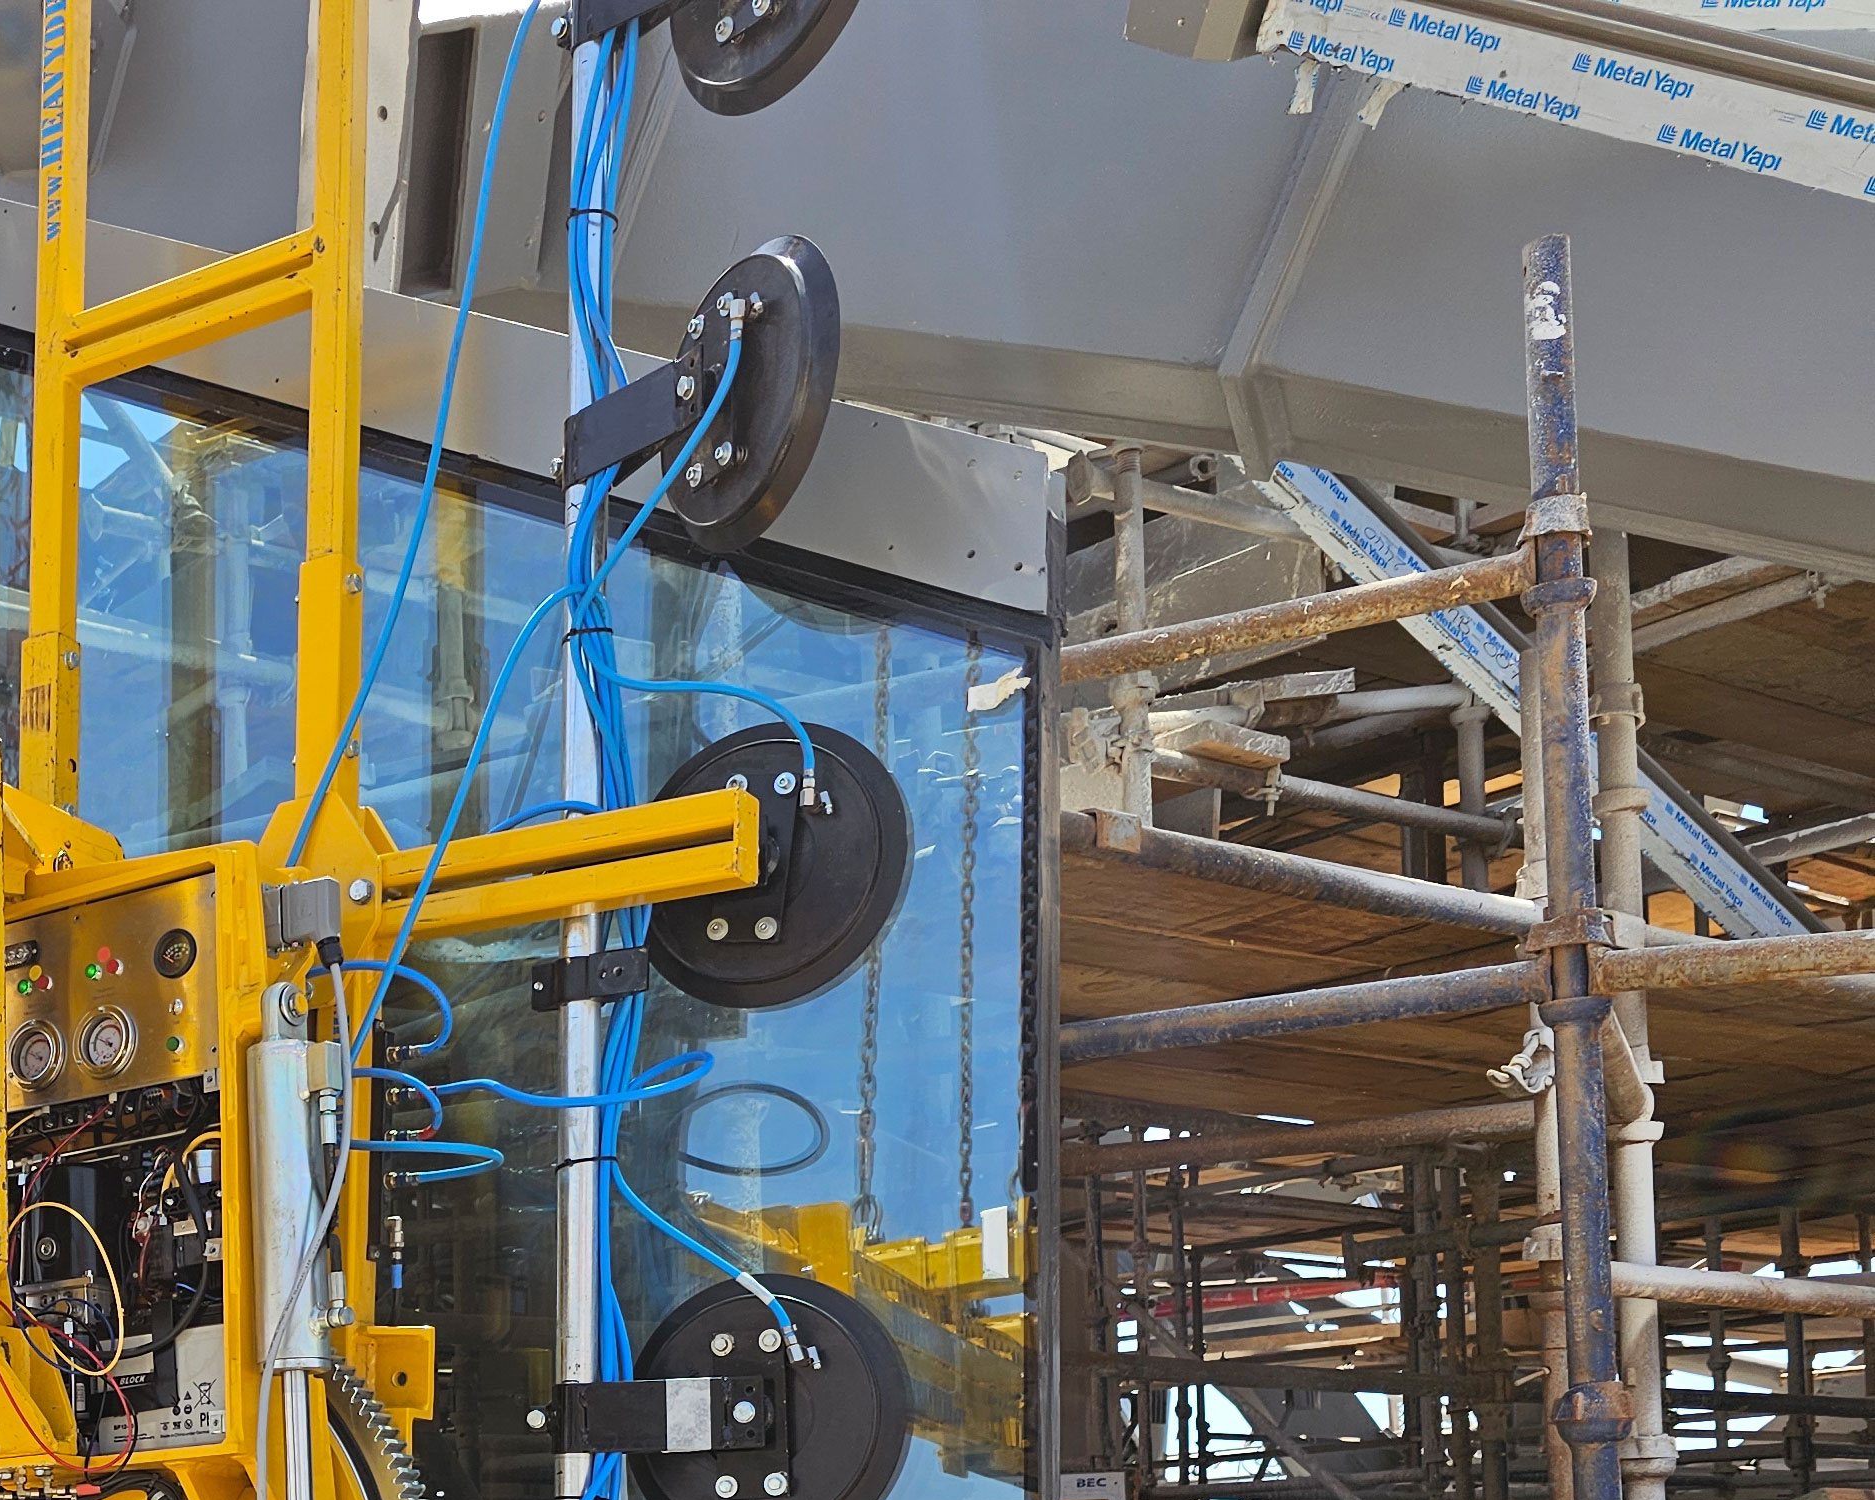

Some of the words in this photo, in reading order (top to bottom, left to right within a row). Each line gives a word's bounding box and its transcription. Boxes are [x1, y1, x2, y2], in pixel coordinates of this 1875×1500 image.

[1408, 14, 1460, 41] Metal
[1465, 26, 1501, 51] Yapı
[1308, 34, 1356, 61] Metal
[1358, 49, 1395, 73] Yapı
[1594, 57, 1651, 87] Metal
[1654, 71, 1695, 100] Yapı
[1486, 80, 1541, 109] Metal
[1543, 95, 1581, 120] Yapı
[1829, 114, 1875, 144] Meta
[1679, 128, 1739, 159] Metal
[1742, 143, 1782, 172] Yapı
[1278, 462, 1295, 480] apı
[1675, 810, 1702, 841] Metal
[1748, 881, 1775, 913] Metal
[120, 1375, 146, 1386] BLOCK
[1076, 1477, 1107, 1488] BEC
